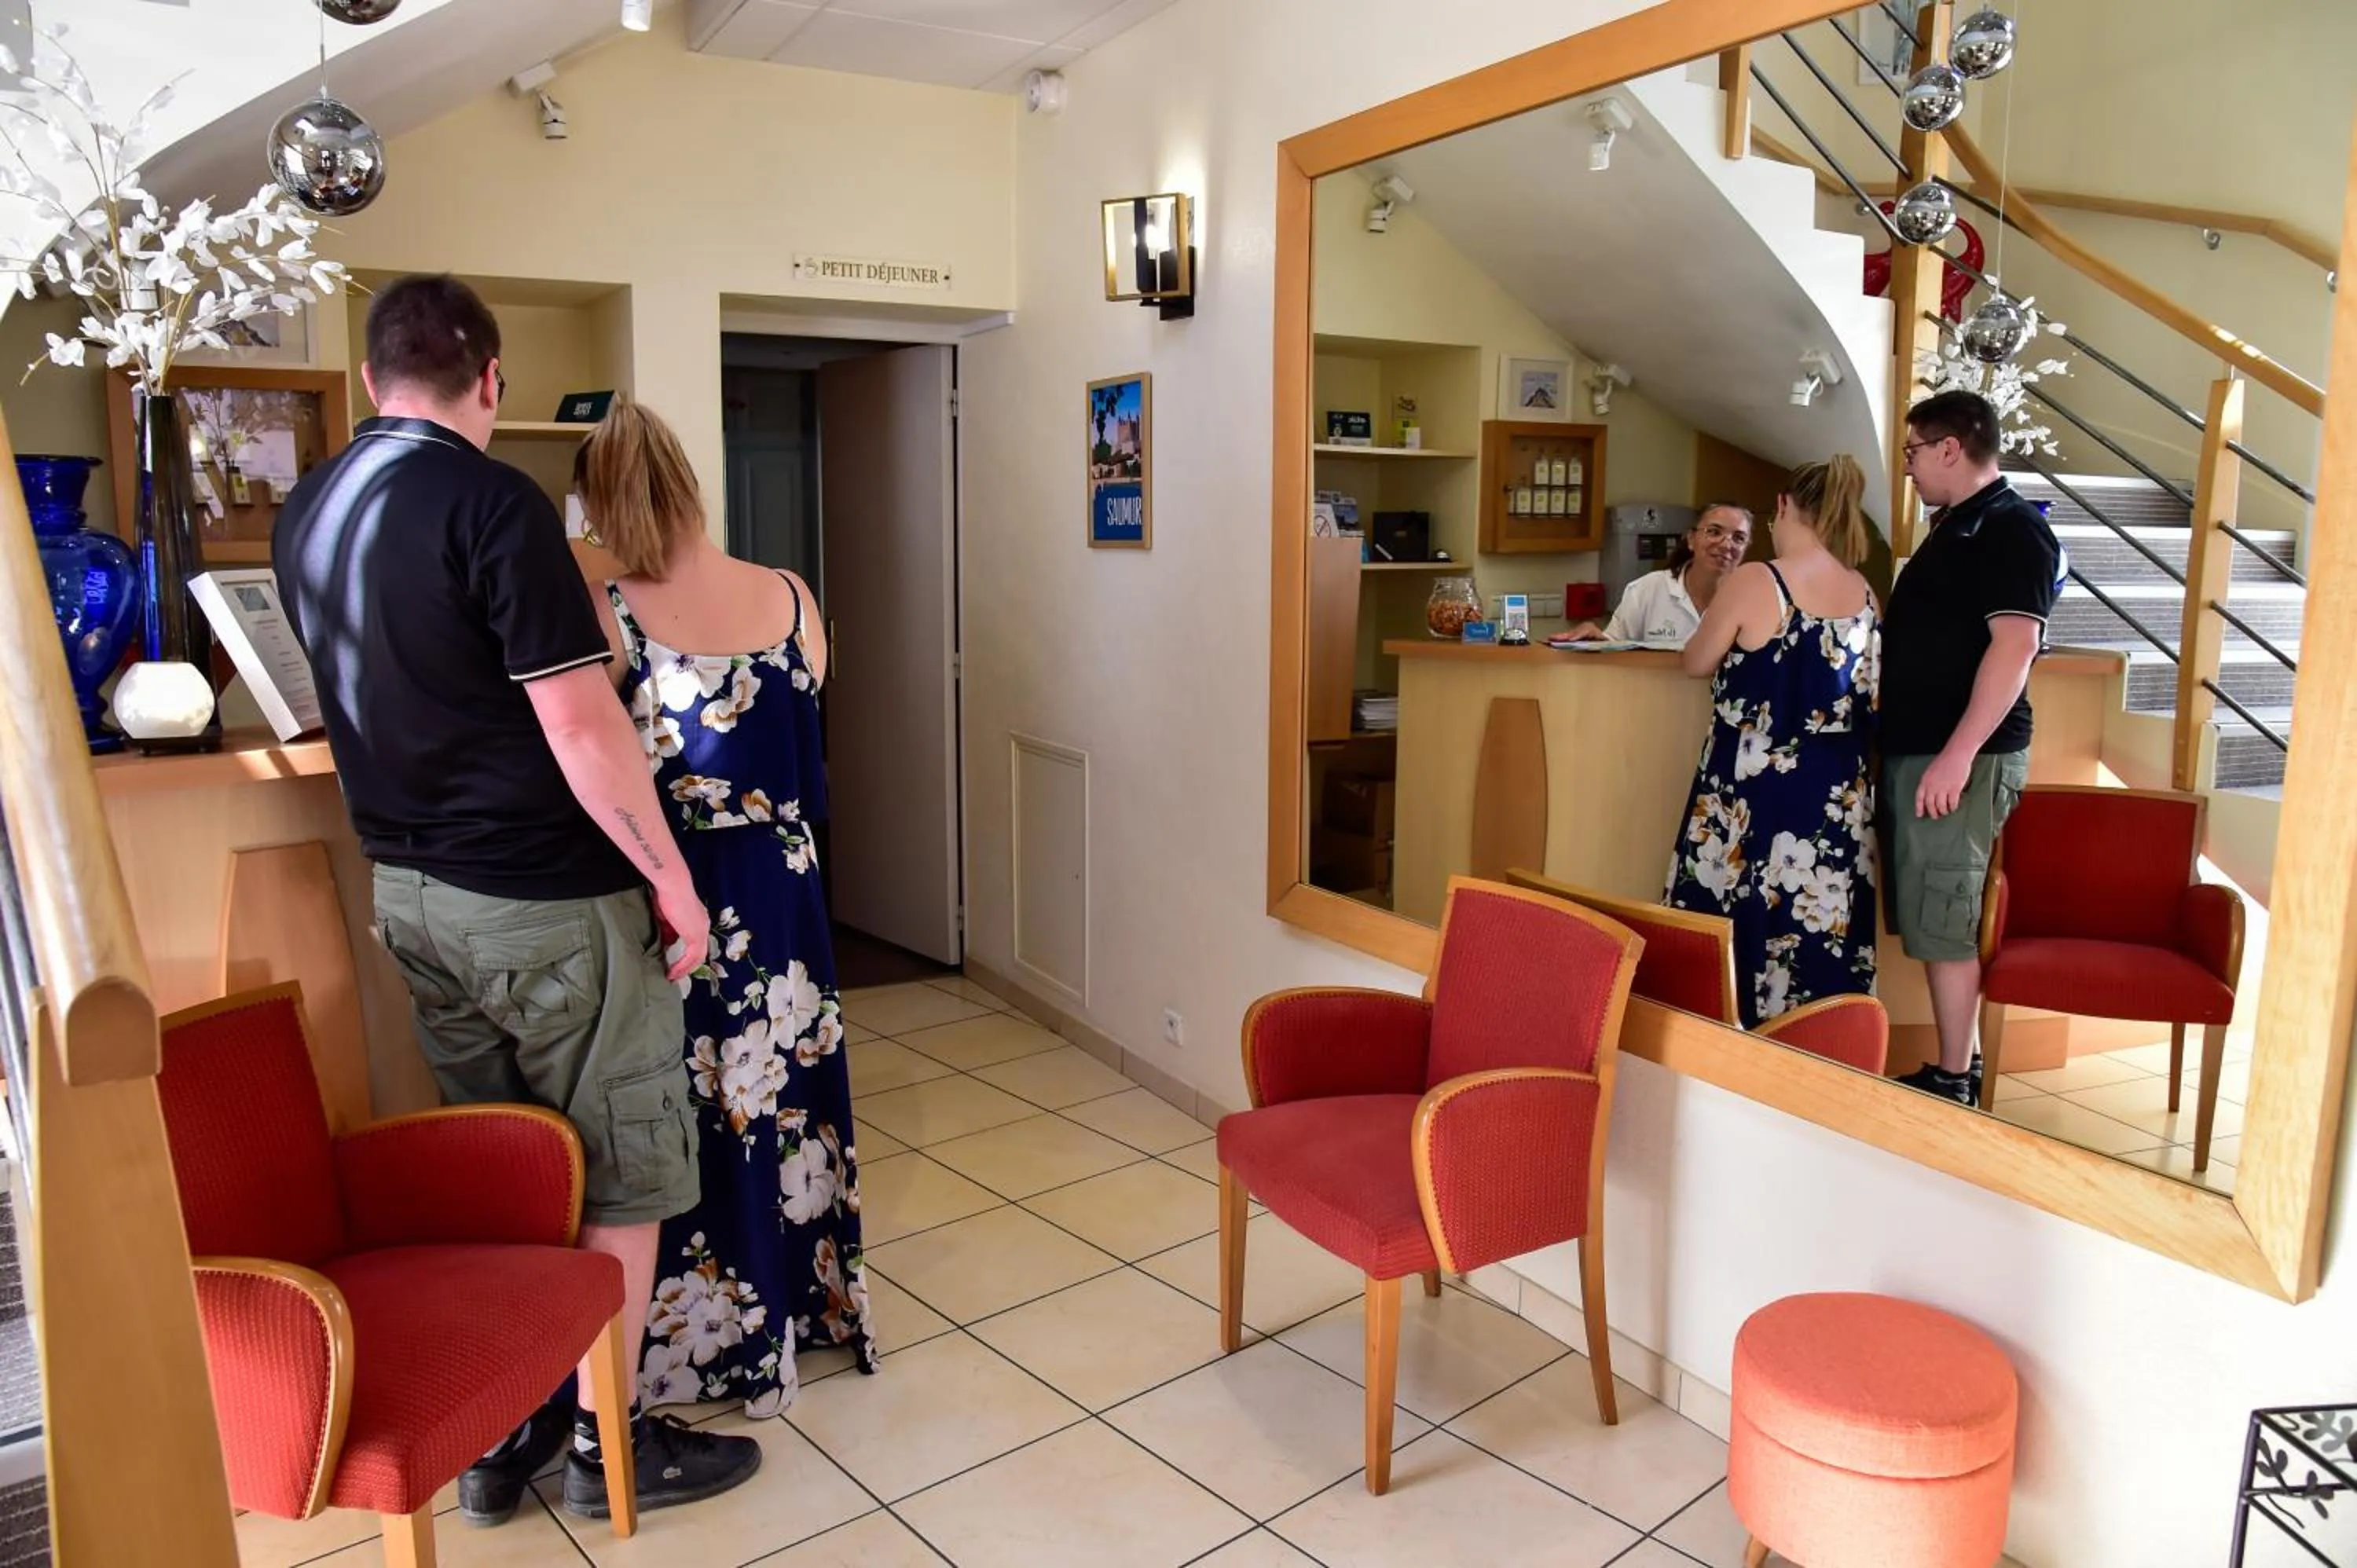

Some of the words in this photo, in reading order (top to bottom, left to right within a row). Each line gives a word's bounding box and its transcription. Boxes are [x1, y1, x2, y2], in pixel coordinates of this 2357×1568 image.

[822, 261, 863, 278] PETIT
[867, 262, 939, 284] DÉJEUNER
[1107, 496, 1142, 526] SAUMUR
